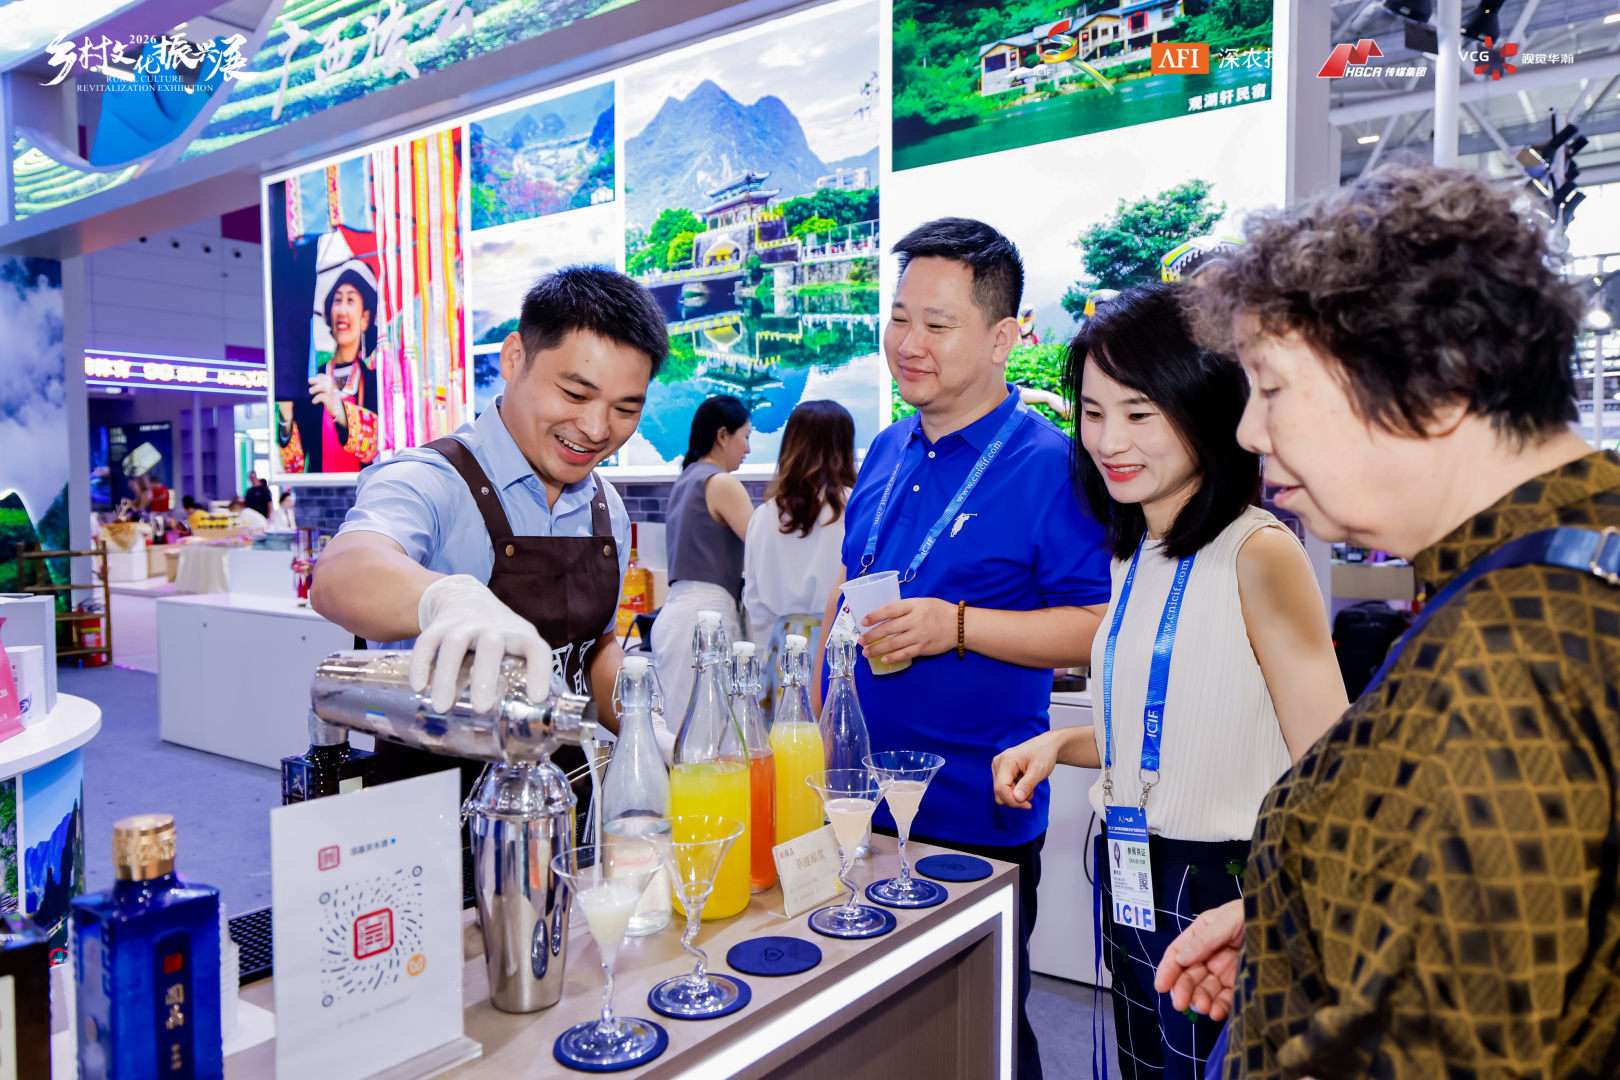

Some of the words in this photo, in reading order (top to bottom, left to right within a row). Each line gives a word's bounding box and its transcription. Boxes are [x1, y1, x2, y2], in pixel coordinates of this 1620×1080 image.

[1187, 83, 1267, 112] 观湖轩民宿
[956, 439, 1004, 504] www.cnicif.com
[920, 535, 936, 556] ICIF
[1146, 709, 1160, 738] ICIF
[1115, 902, 1152, 928] ICIF
